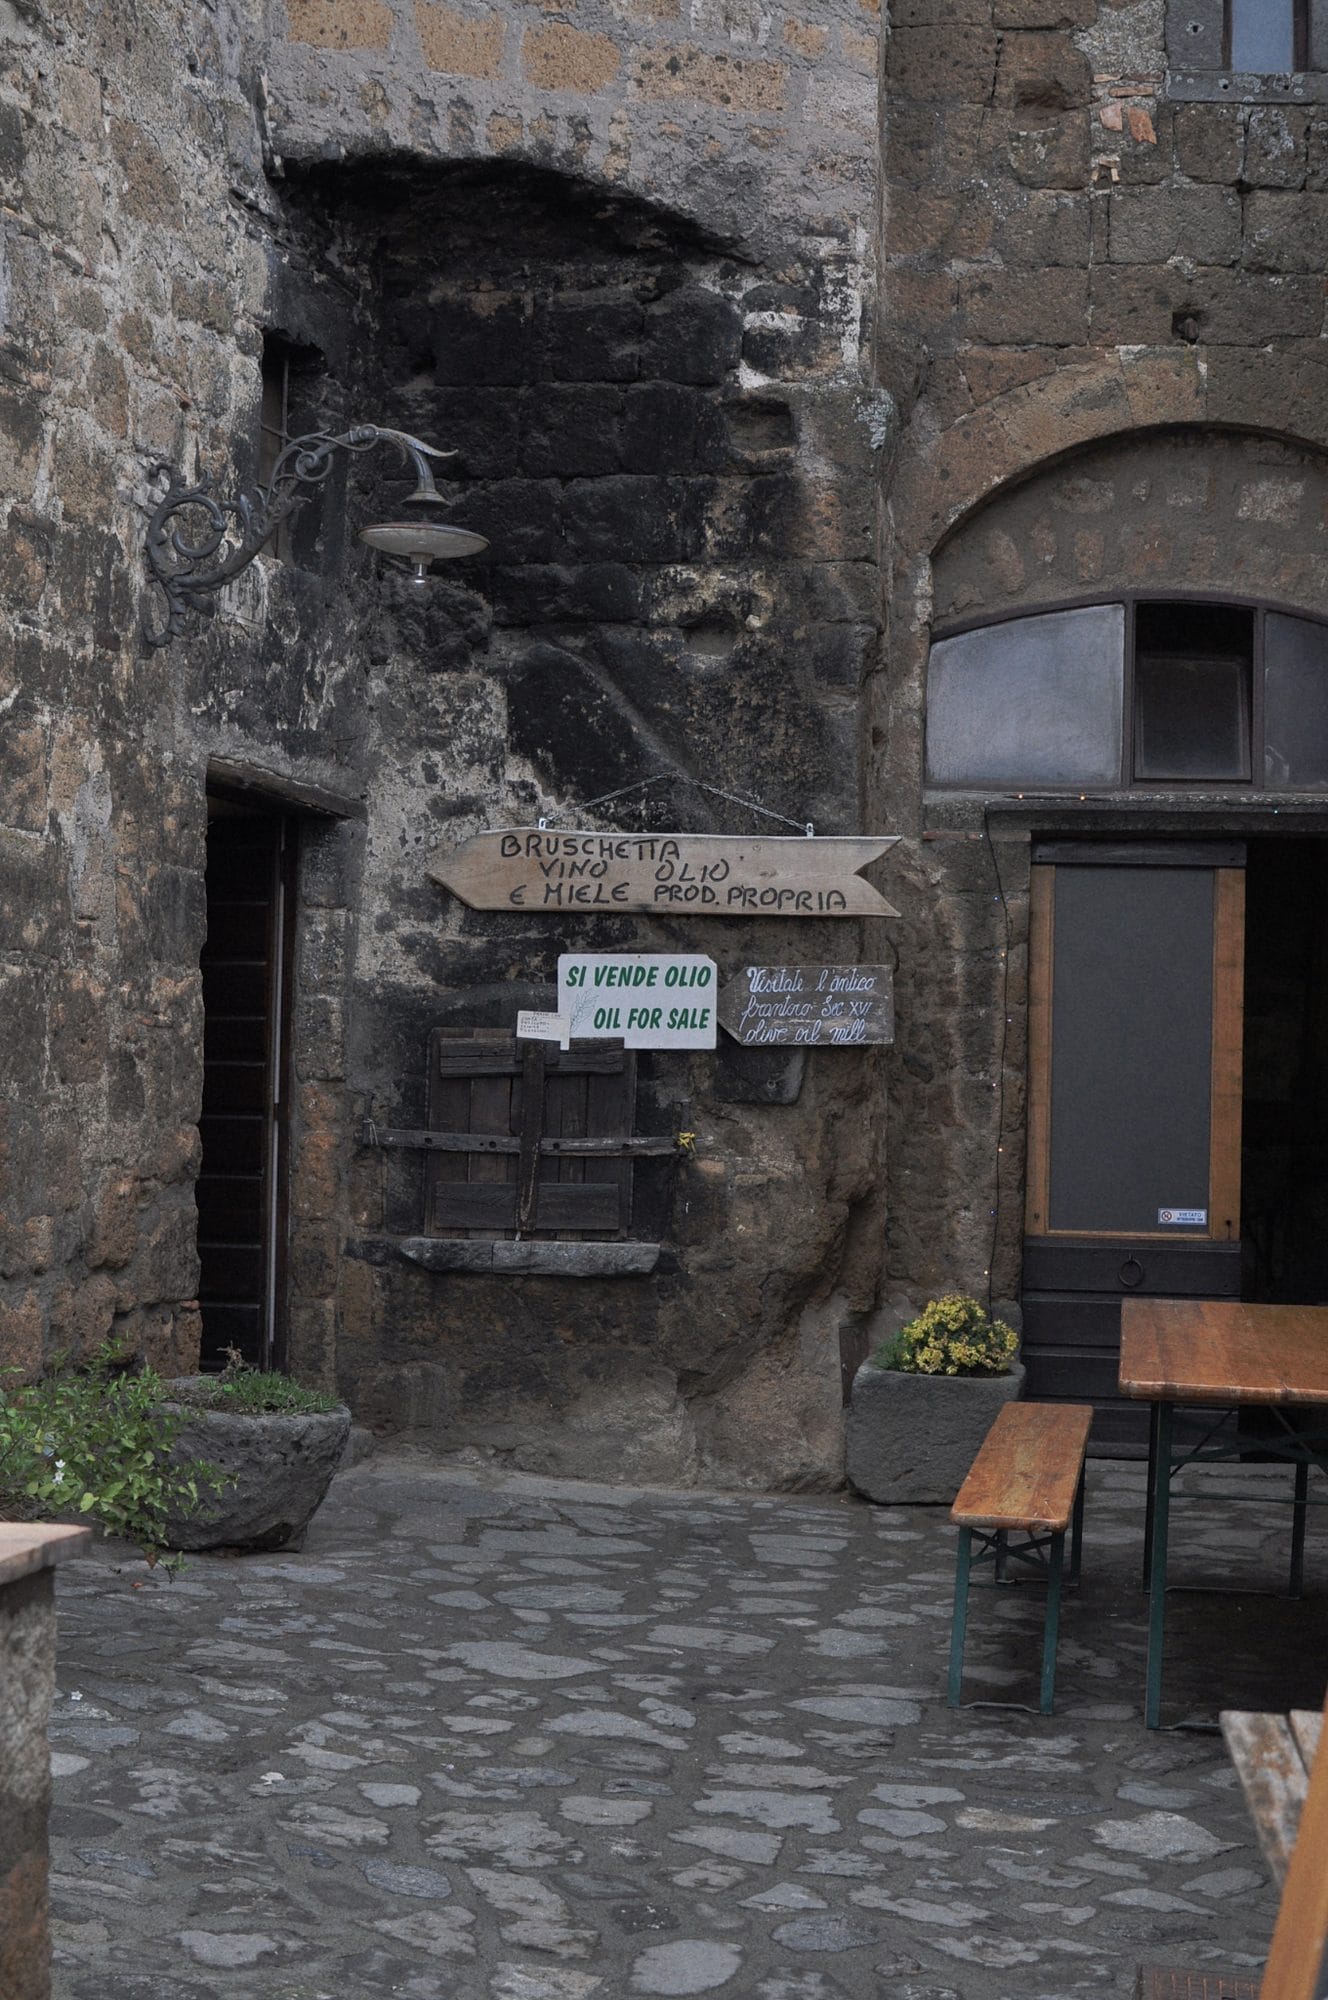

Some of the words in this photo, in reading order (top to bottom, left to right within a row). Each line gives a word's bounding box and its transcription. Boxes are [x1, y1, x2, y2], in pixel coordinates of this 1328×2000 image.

[501, 834, 681, 862] BRUSCHETTA
[540, 859, 608, 880] VINO
[655, 858, 731, 882] OLIO
[509, 884, 528, 905] E
[544, 881, 631, 905] MIELE
[654, 884, 720, 906] PROD.
[727, 885, 848, 911] PROPRIA
[565, 965, 588, 988] SI
[594, 965, 660, 988] VENDE
[664, 965, 712, 988] OLIO
[747, 966, 804, 993] Visitate
[593, 1007, 621, 1030] OIL
[627, 1007, 663, 1030] FOR
[667, 1007, 711, 1030] SALE
[743, 1019, 789, 1044] olive
[795, 1019, 823, 1043] oil
[829, 1018, 867, 1044] mill
